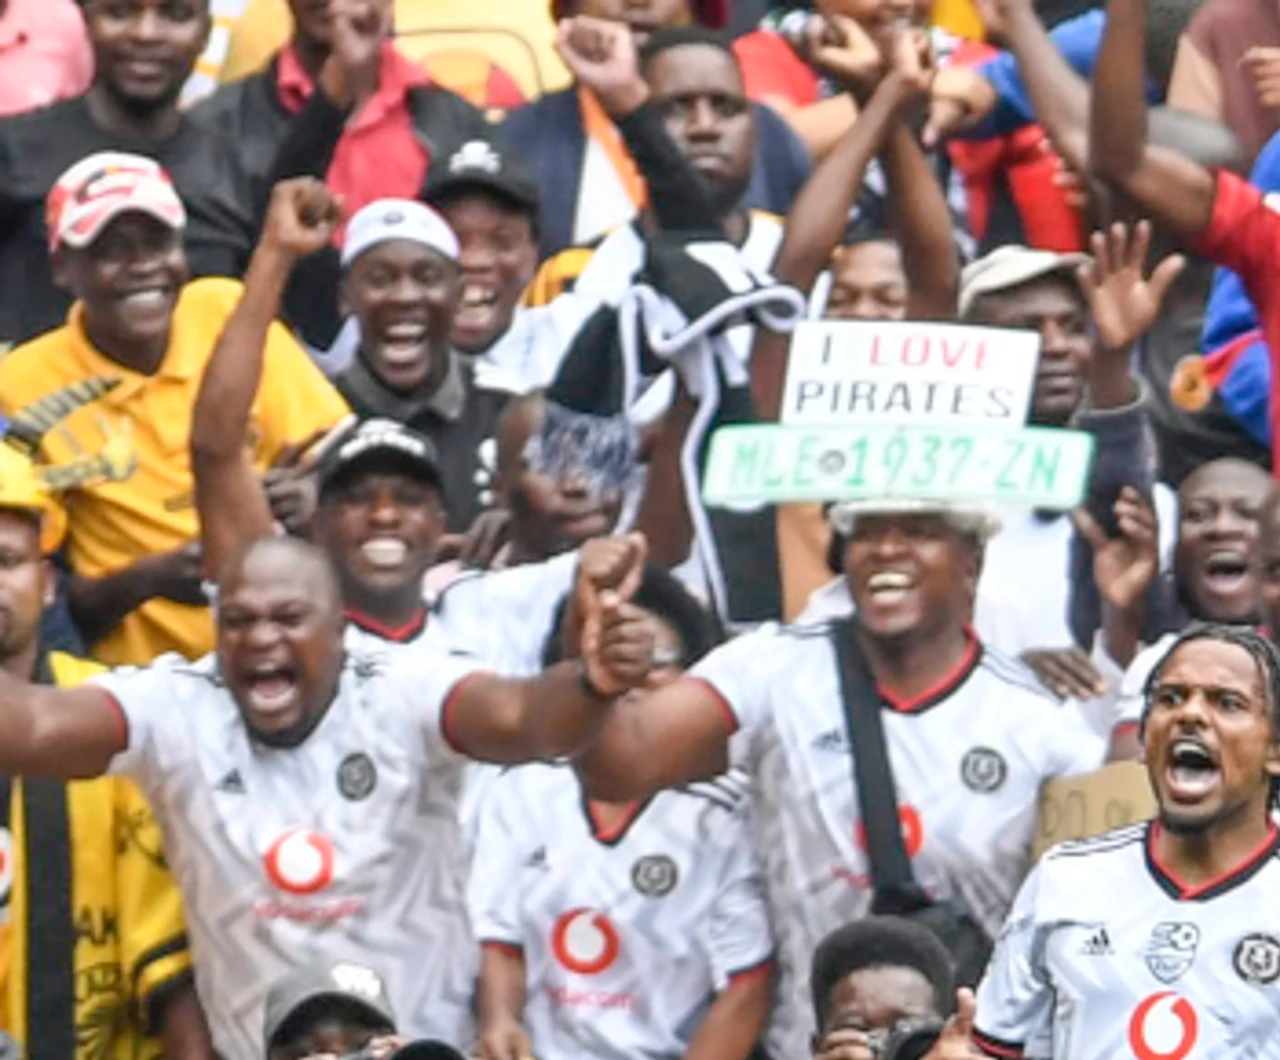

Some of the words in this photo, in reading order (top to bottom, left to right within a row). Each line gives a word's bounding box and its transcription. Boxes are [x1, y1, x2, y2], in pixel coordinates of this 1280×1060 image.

[821, 334, 833, 365] I
[868, 333, 990, 372] LOVE
[793, 378, 1017, 419] PIRATES
